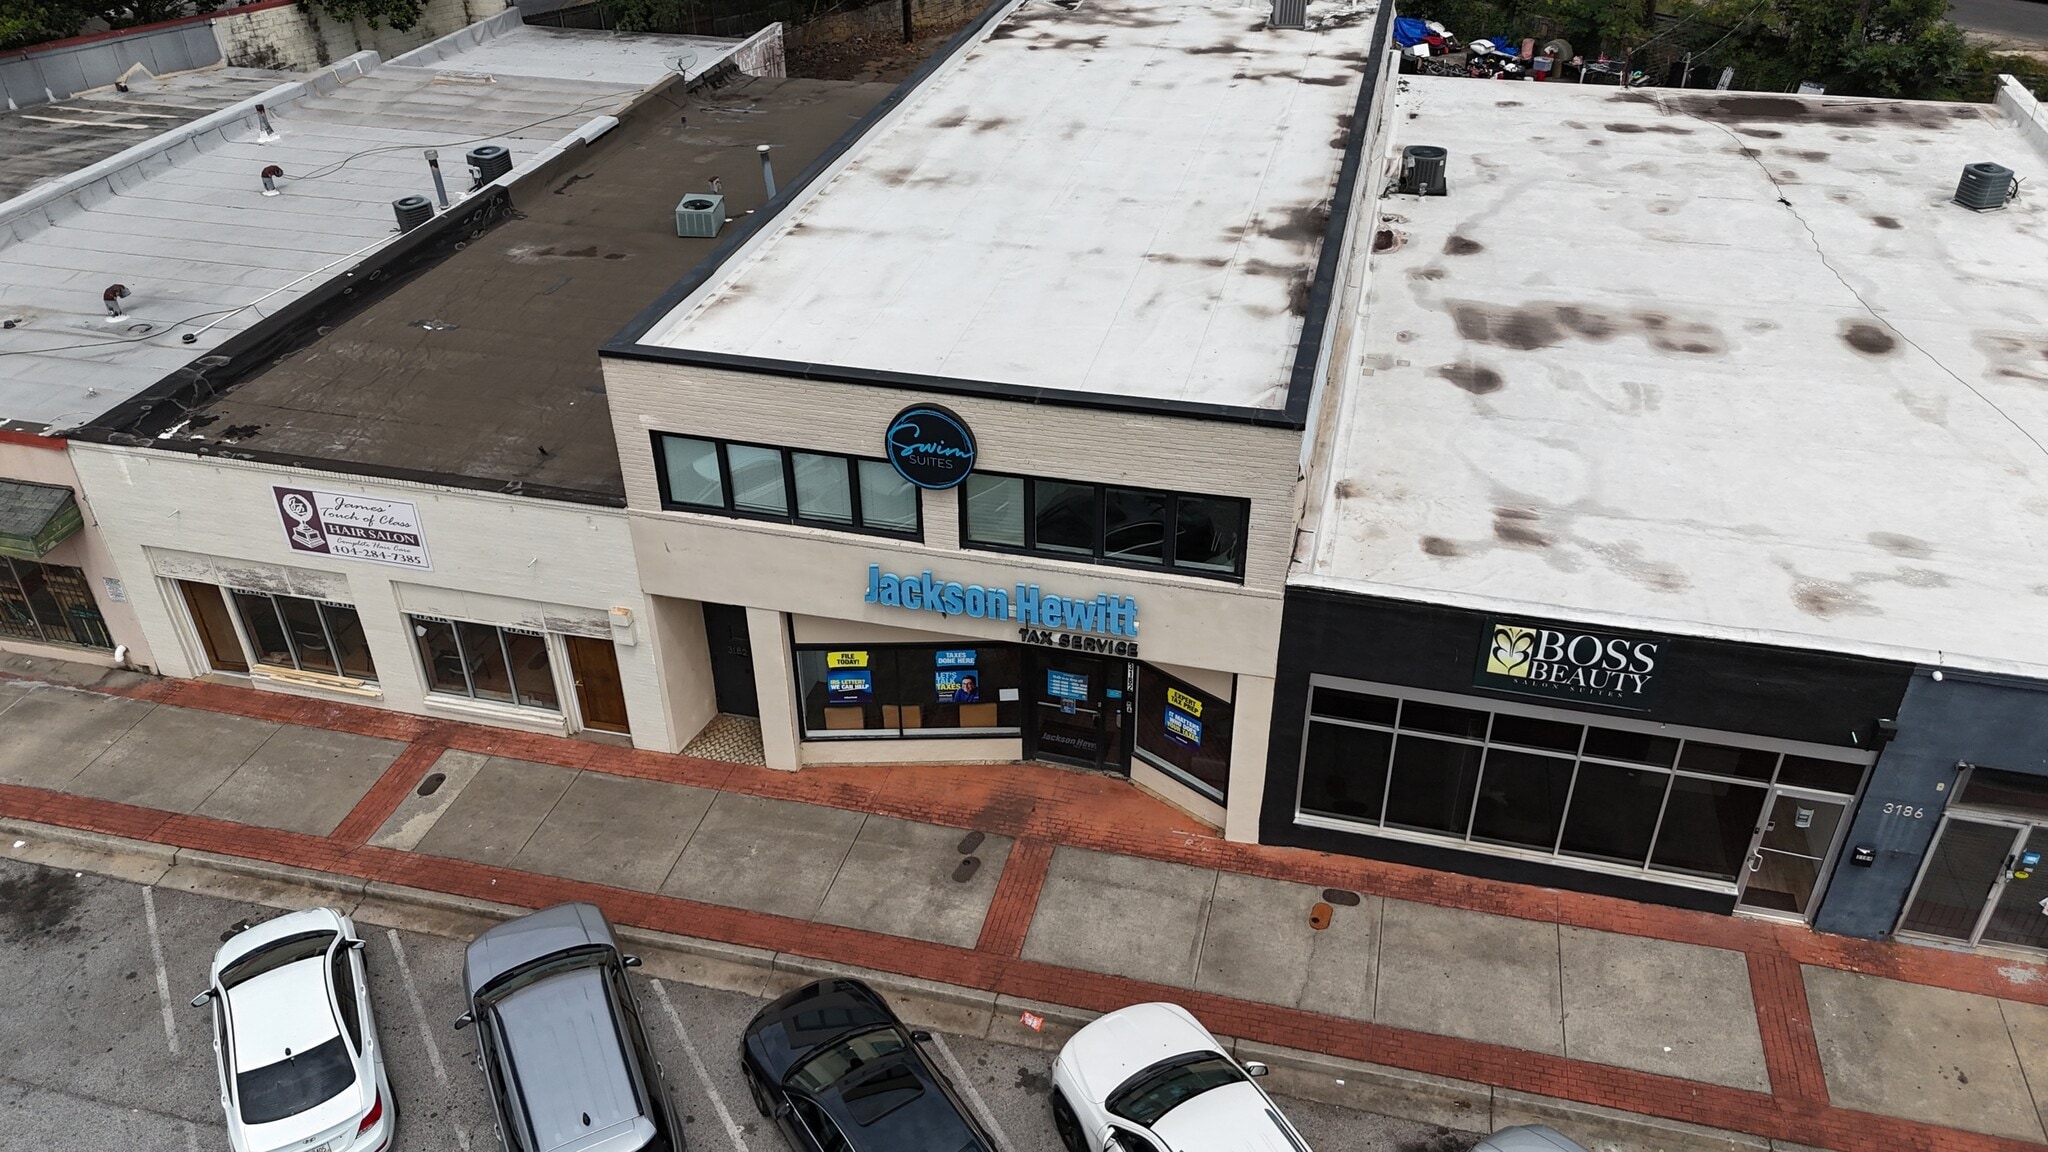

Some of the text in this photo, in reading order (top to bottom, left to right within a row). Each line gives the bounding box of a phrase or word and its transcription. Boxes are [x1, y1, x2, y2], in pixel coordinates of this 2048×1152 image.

[888, 423, 974, 458] Swim
[908, 454, 953, 469] SUITES
[334, 496, 392, 513] James'
[320, 507, 412, 528] Touch of Class
[328, 524, 415, 544] HAIR SALON
[332, 545, 421, 564] 404-284-7385
[336, 537, 411, 553] Complete Hair Care
[865, 563, 1139, 637] Jackson Hewitt
[1018, 628, 1139, 657] TAX SERVICE
[1533, 629, 1658, 674] BOSS
[935, 671, 957, 679] LET'S
[1528, 661, 1653, 694] BEAUTY
[1513, 678, 1624, 698] SALON SUITES
[1171, 695, 1199, 714] TAX PREP
[1174, 692, 1196, 706] EXPERT
[1168, 710, 1200, 732] IT MATTERS
[1169, 717, 1197, 735] WHO DOES
[1041, 732, 1076, 745] Jackson
[1167, 720, 1181, 733] YOUR
[1182, 729, 1199, 743] TAXES
[1883, 802, 1924, 819] 3186
